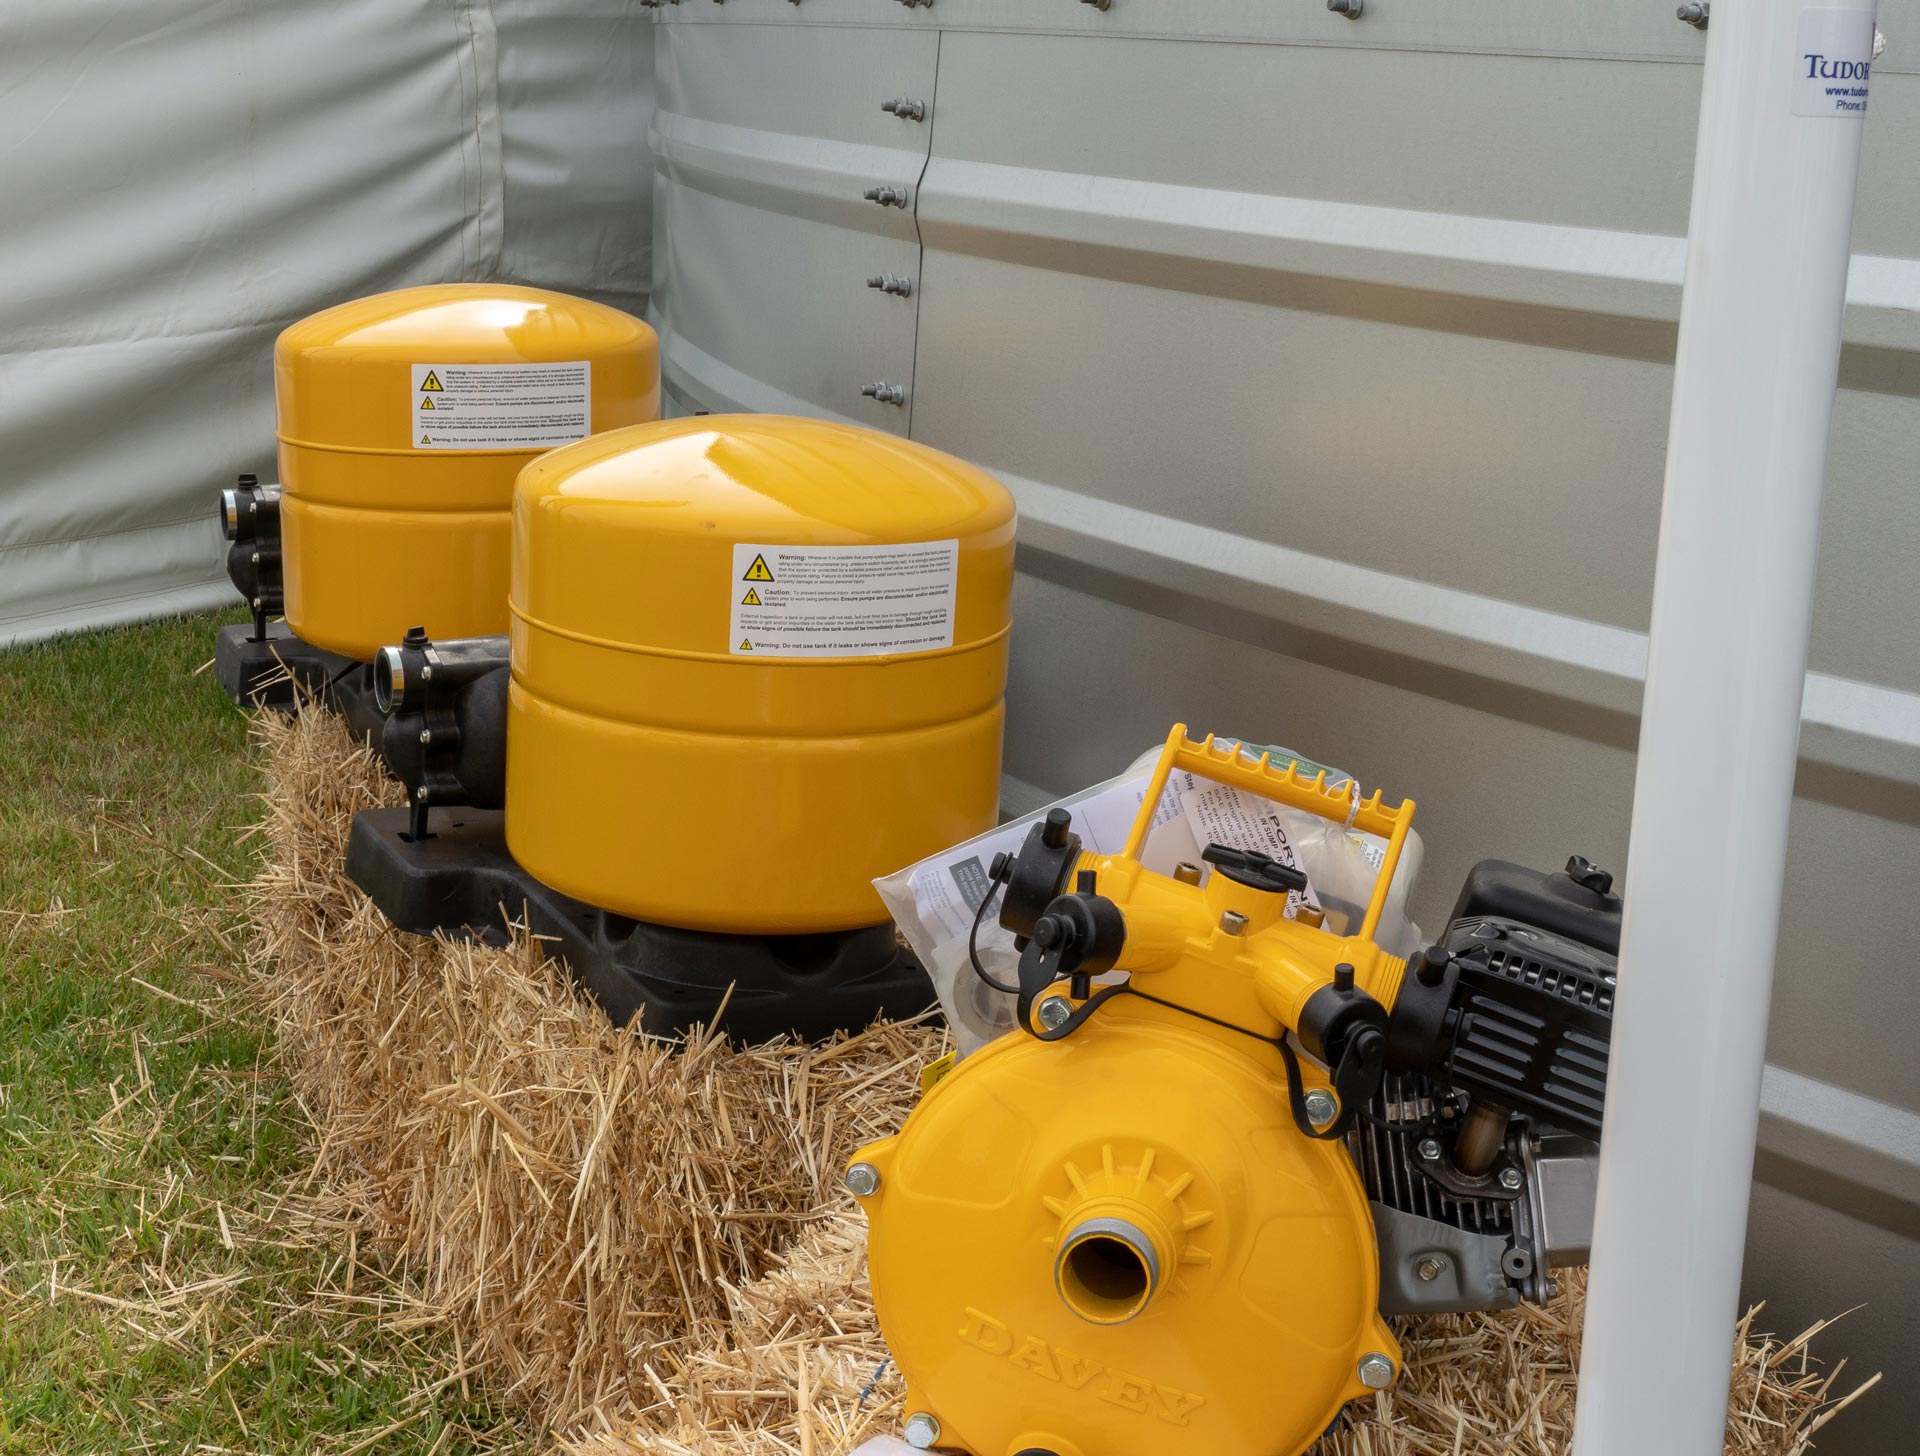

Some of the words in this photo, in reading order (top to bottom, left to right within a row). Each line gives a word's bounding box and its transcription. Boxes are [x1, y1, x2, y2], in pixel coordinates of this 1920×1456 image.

[1804, 55, 1870, 80] TUDOR
[900, 637, 922, 645] corrosion
[1198, 793, 1209, 811] may
[1226, 801, 1243, 830] engine
[1212, 807, 1229, 840] extreme
[1222, 812, 1240, 846] 10W-30
[1264, 826, 1277, 849] SUMP
[957, 1305, 1208, 1428] DAVEY
